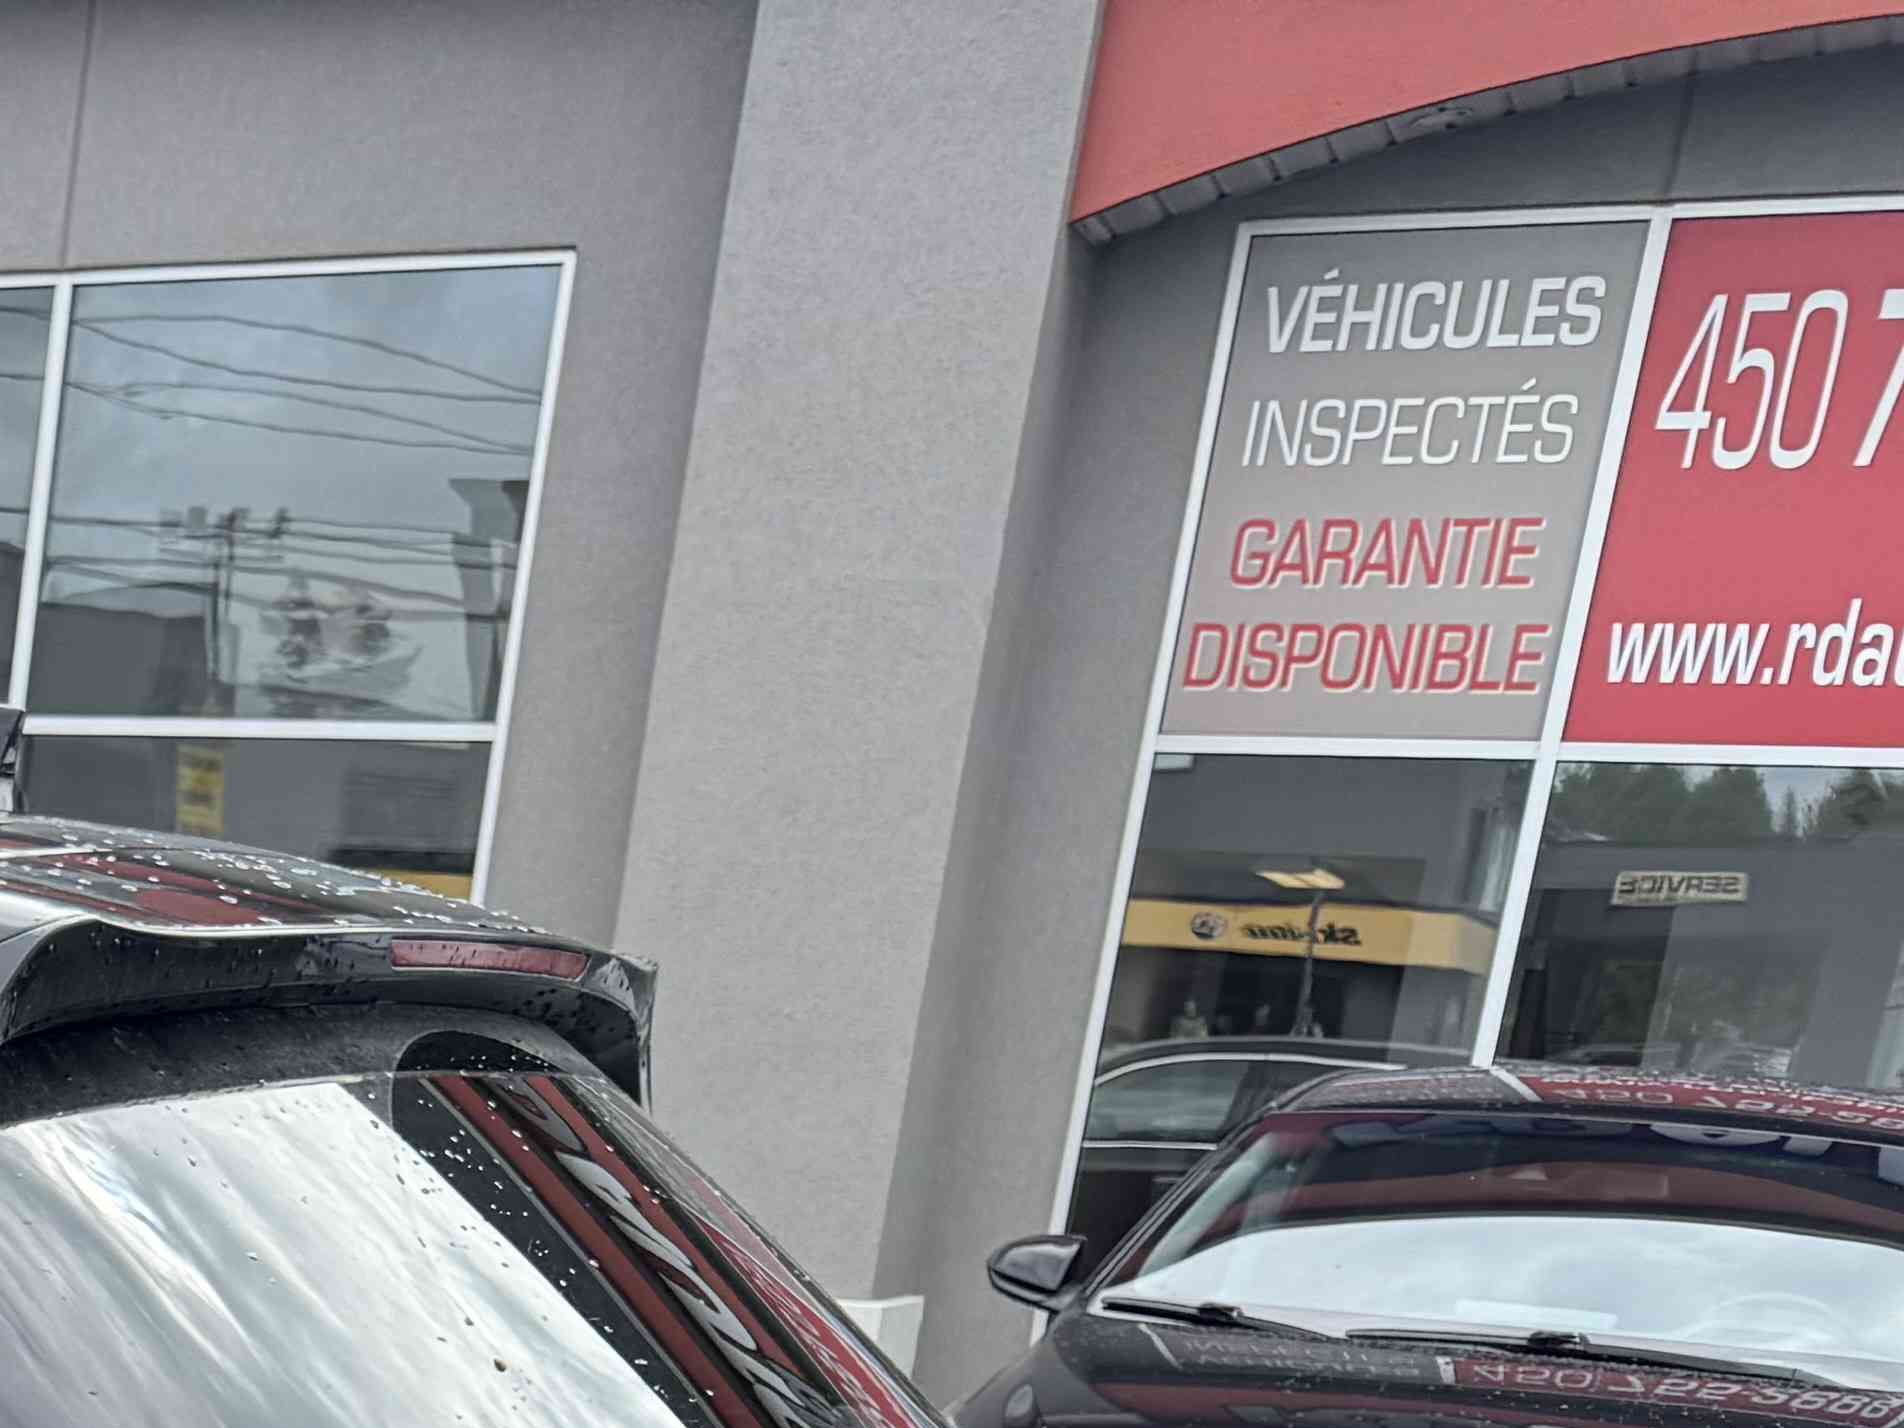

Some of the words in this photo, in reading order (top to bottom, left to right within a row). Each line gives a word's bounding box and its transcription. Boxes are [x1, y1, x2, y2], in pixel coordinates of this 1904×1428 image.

[1267, 268, 1606, 353] VÉHICULES
[1241, 377, 1579, 467] INSPECTÉS
[1655, 289, 1848, 470] 450
[1230, 516, 1547, 589] GARANTIE
[1182, 622, 1552, 695] DISPONIBLE
[1607, 598, 1904, 688] www.rda
